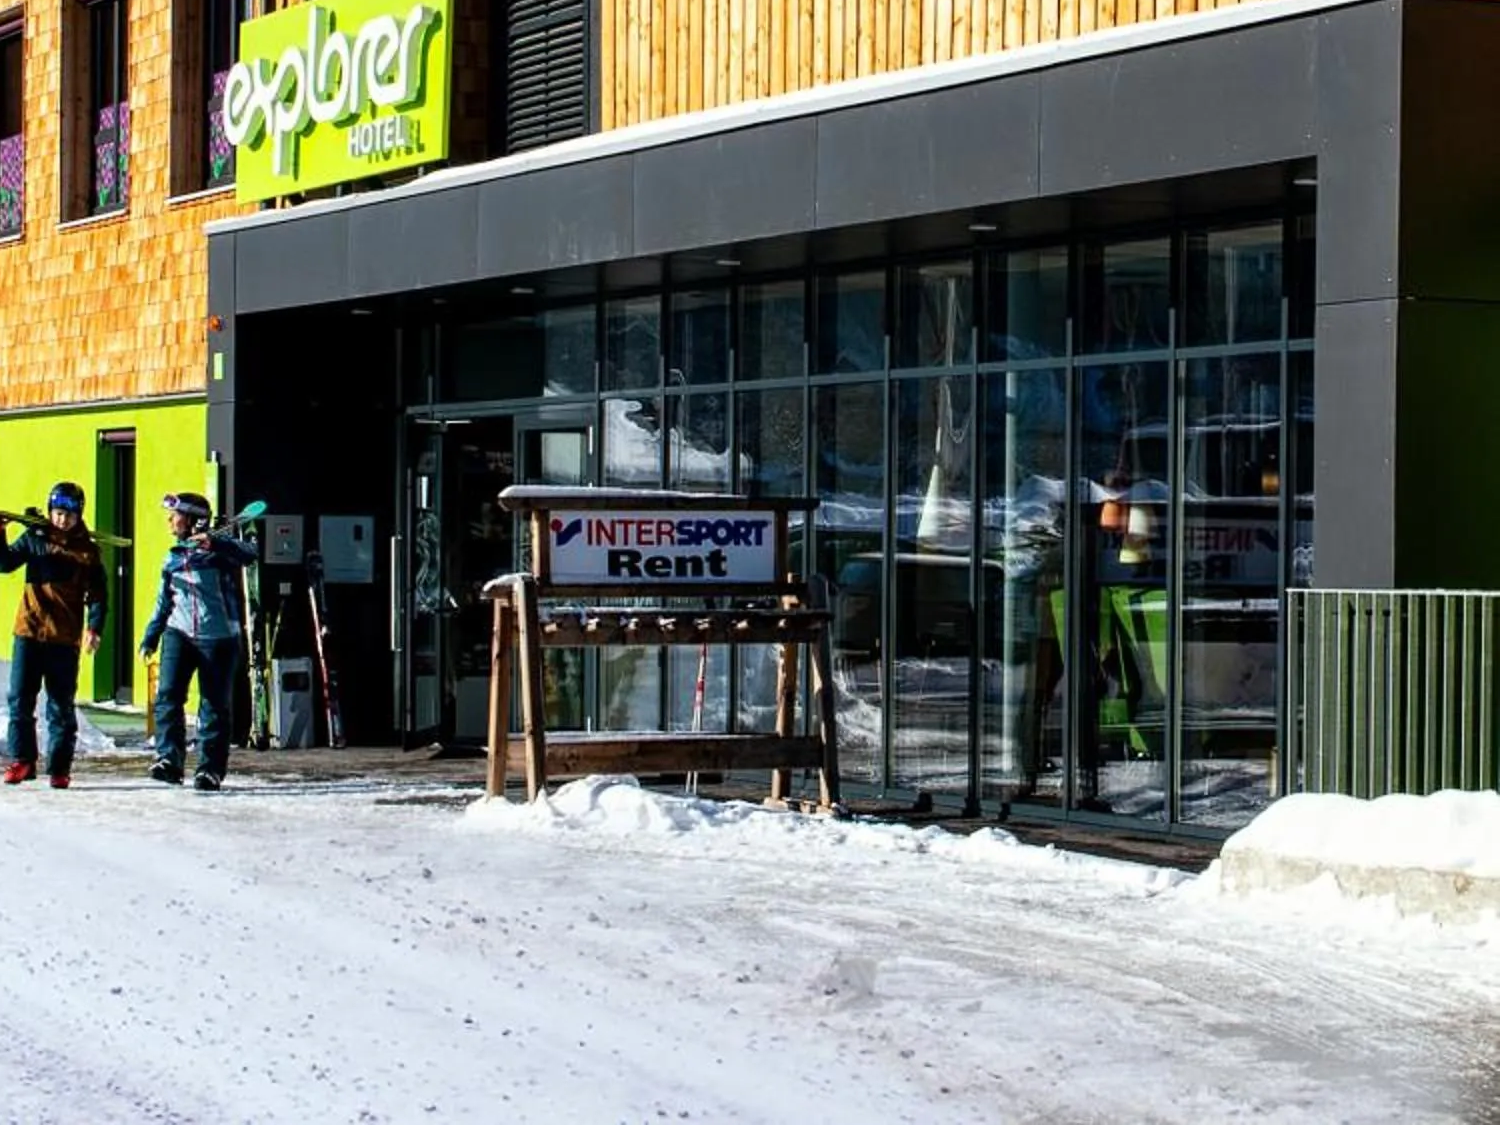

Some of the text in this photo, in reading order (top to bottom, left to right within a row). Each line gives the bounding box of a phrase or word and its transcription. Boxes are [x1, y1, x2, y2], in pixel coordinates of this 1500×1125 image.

[224, 4, 436, 176] explorer
[349, 114, 408, 157] HOTEL
[586, 518, 768, 547] INTERSPORT
[607, 548, 728, 578] Rent
